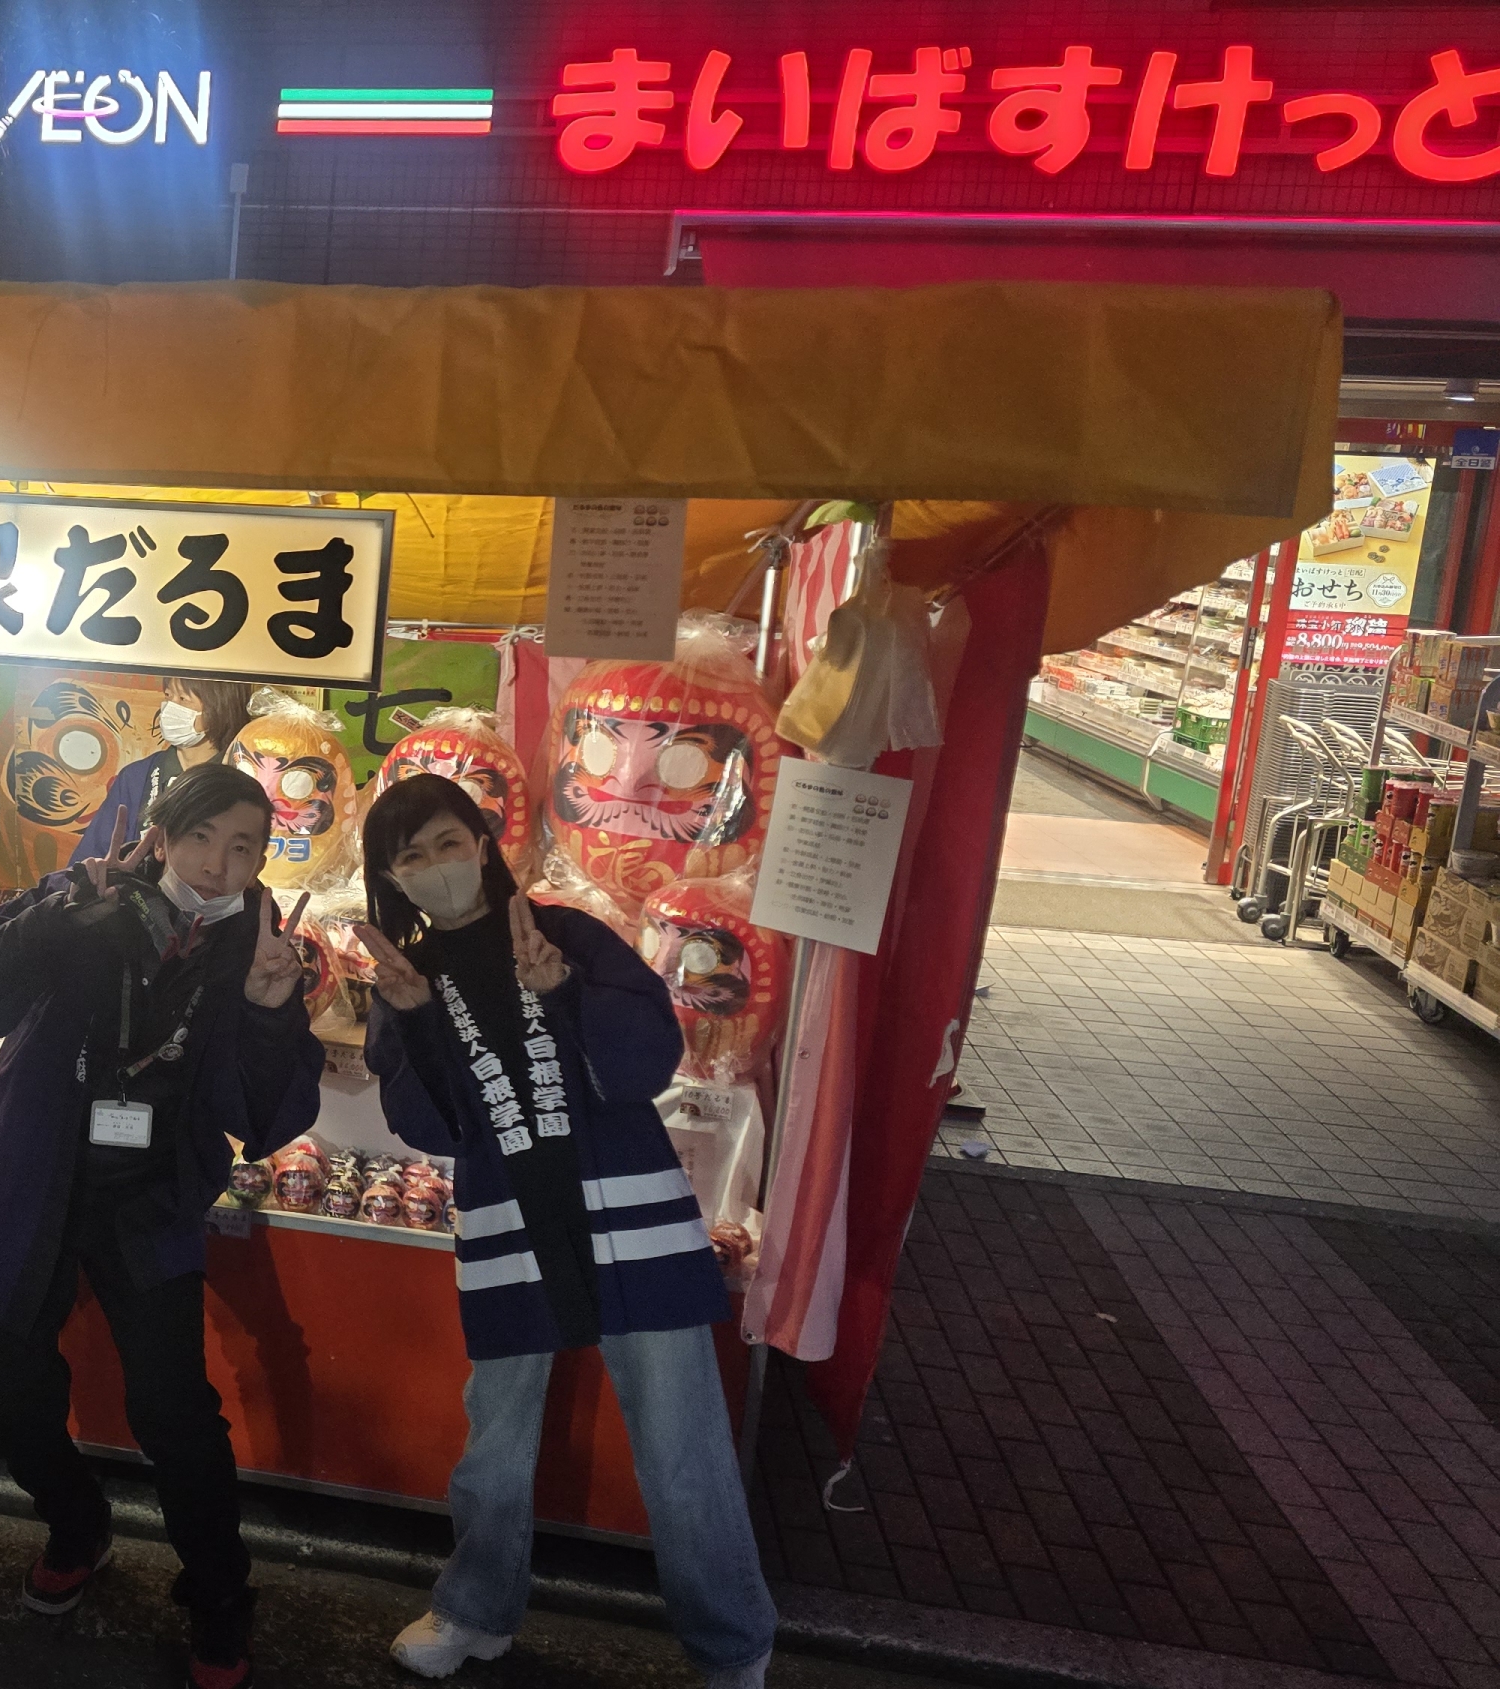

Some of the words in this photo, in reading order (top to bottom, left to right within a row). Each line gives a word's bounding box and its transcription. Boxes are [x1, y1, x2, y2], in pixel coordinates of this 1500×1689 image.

[552, 45, 1500, 182] まいばすけっと
[1291, 577, 1363, 602] おせち
